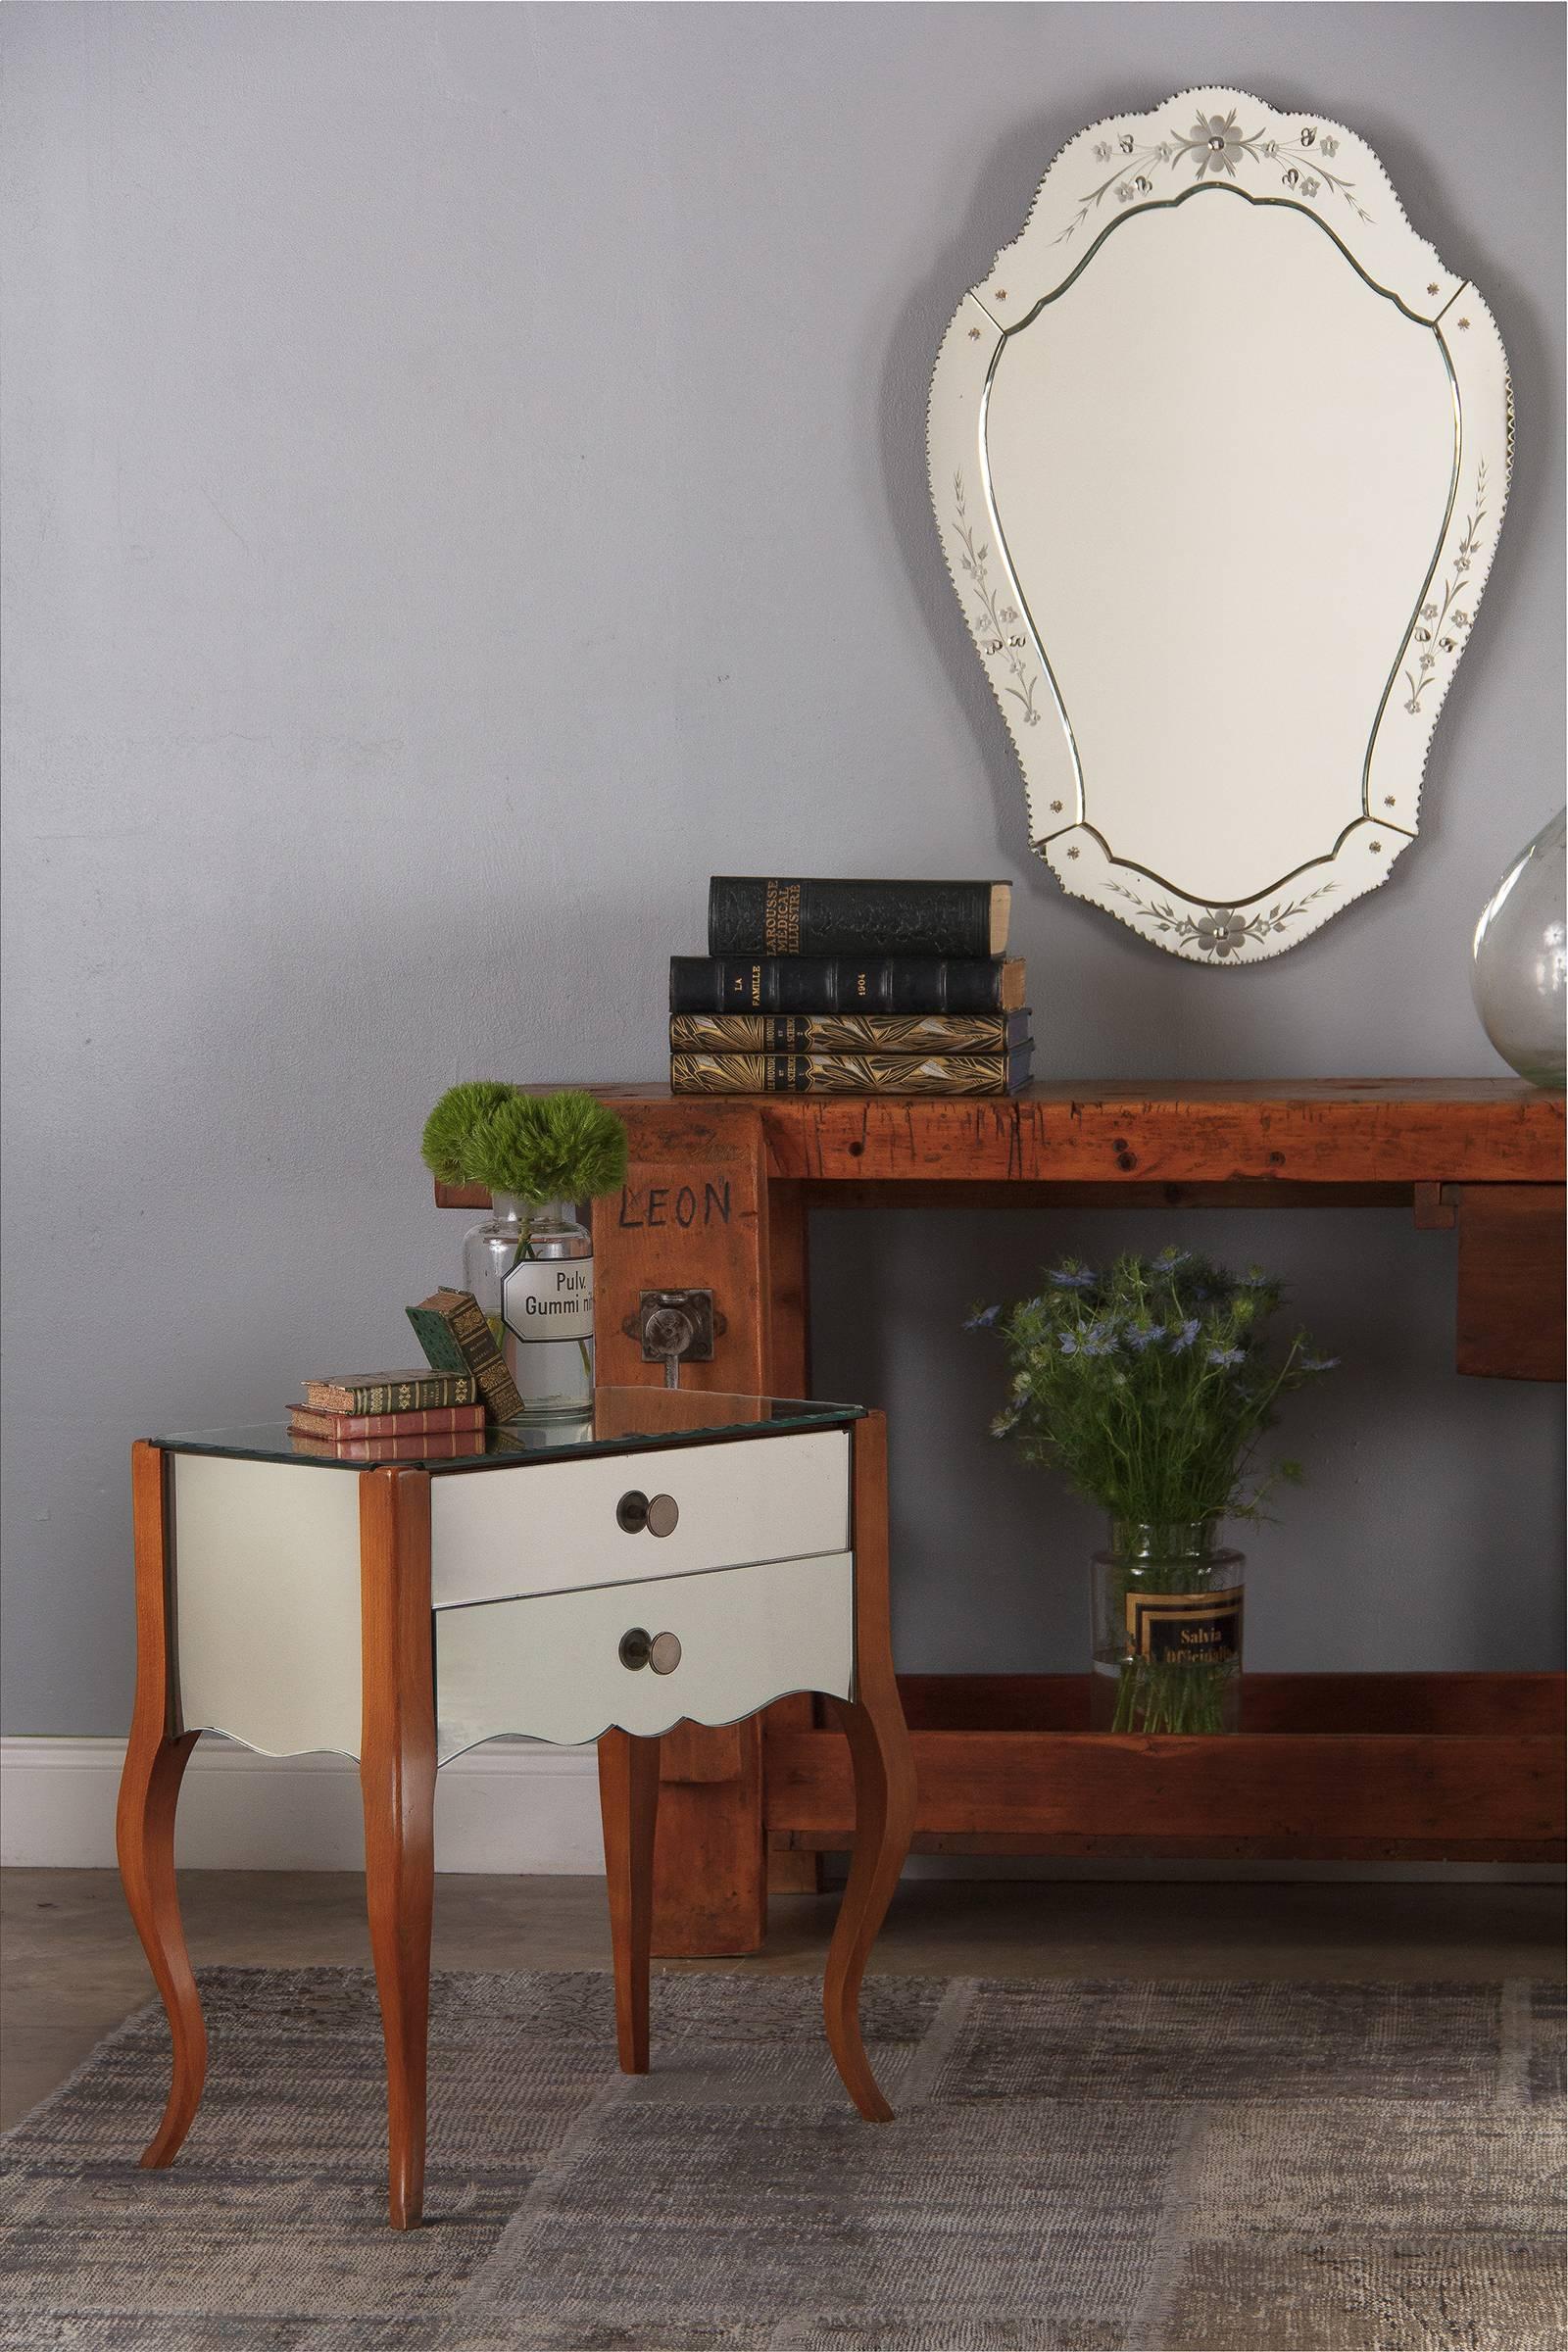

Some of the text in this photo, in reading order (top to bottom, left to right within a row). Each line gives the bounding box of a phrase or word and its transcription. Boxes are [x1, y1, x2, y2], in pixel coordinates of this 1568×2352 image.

[766, 880, 778, 956] LAROUSSE
[735, 977, 743, 991] LA
[752, 965, 760, 1006] FAMILLE
[857, 973, 866, 996] 1904
[767, 1056, 776, 1091] LE MONDE
[618, 1181, 730, 1229] LEON
[557, 1270, 586, 1292] Pulv.
[525, 1294, 579, 1315] Gummi
[1180, 1628, 1222, 1643] Salvia
